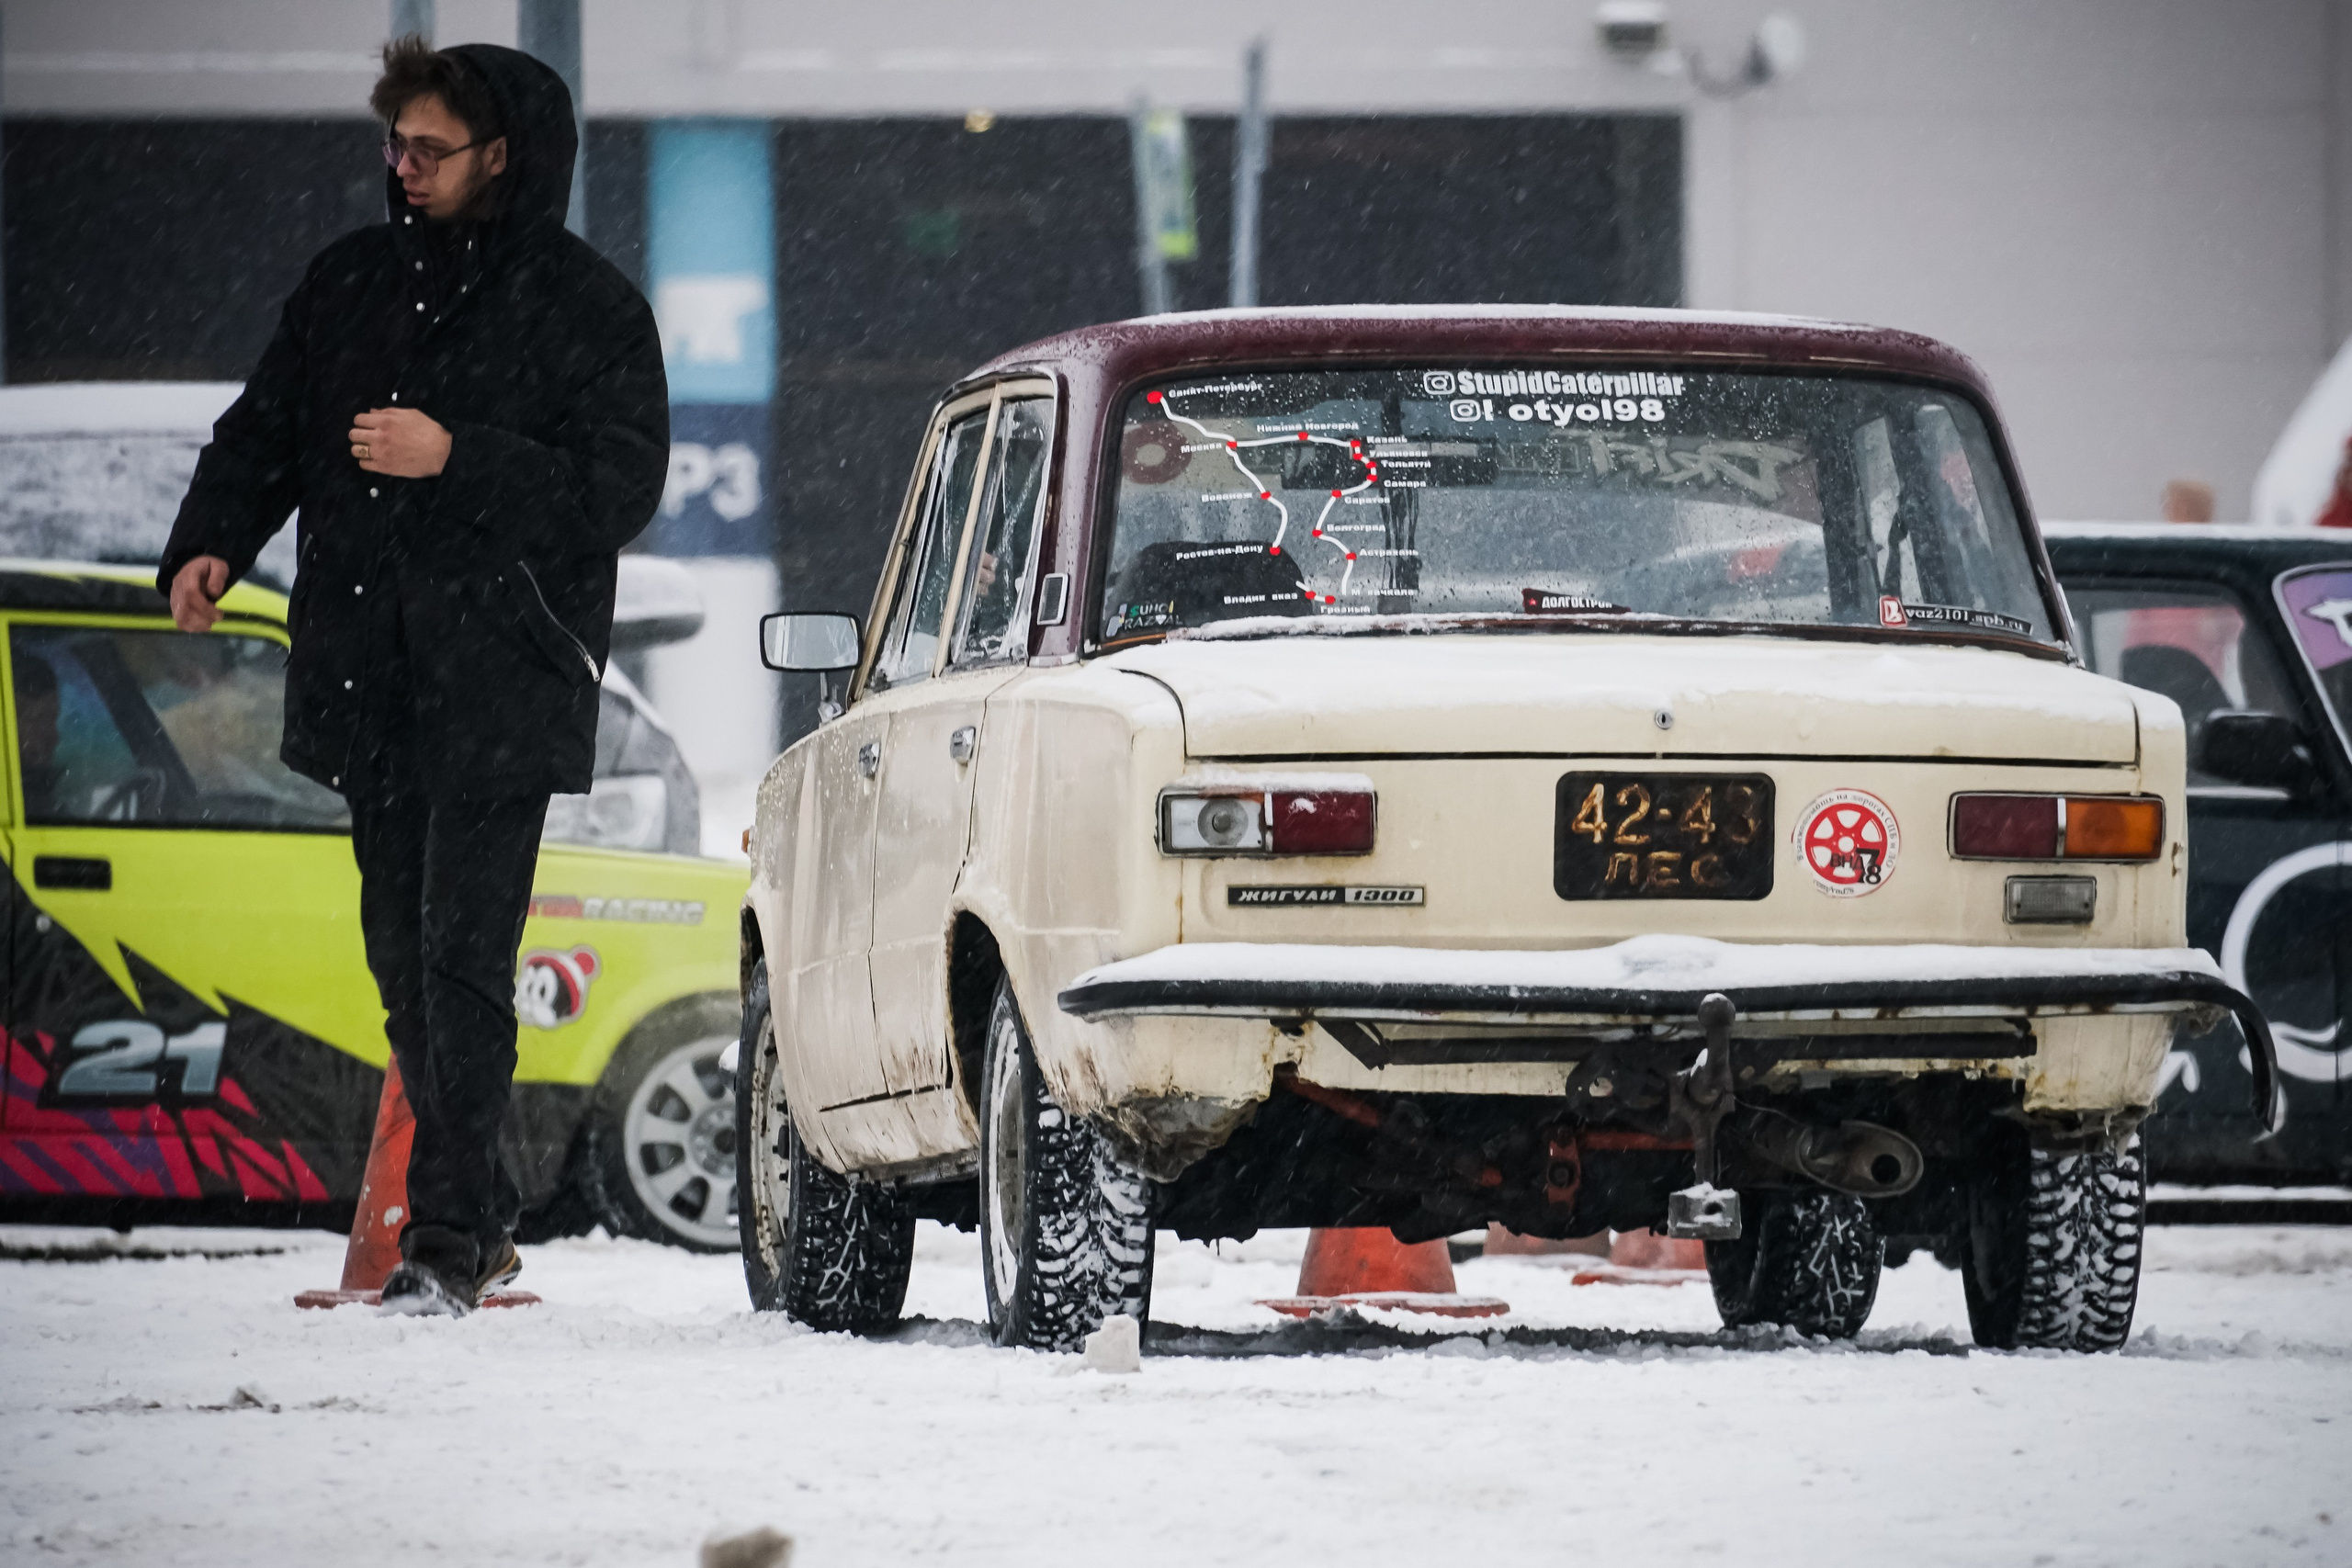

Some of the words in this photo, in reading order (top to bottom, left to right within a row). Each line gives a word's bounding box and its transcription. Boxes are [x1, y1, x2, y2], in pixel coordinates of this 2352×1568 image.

[1457, 370, 1684, 397] StupidCaterpillar
[1181, 443, 1222, 453] Москва
[1384, 479, 1427, 488] Самара
[1238, 889, 1338, 902] ЖИГУЛИ
[1353, 890, 1415, 901] 1300
[584, 897, 705, 925] RACING
[59, 1021, 227, 1095] 21
